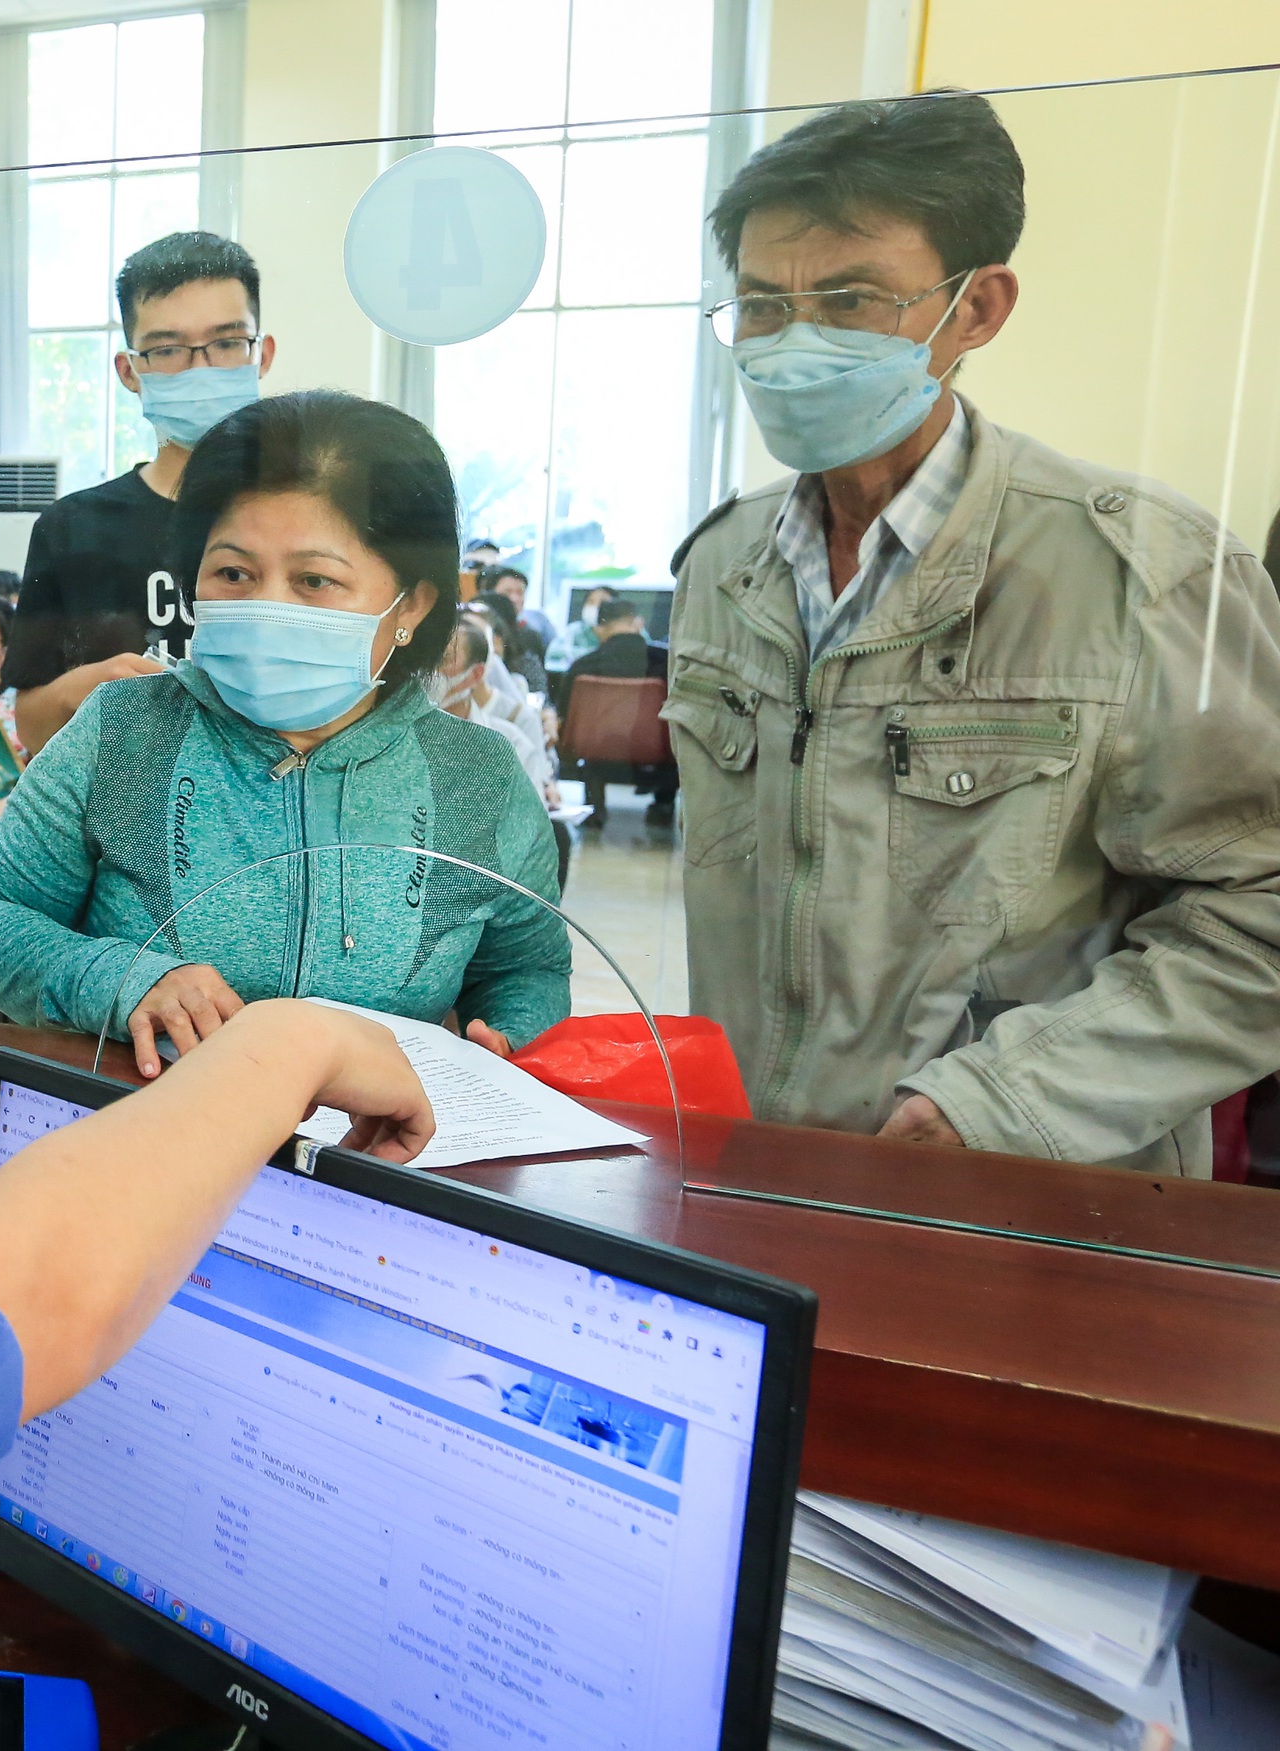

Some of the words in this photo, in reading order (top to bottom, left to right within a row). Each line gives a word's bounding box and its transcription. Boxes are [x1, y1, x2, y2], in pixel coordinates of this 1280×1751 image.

[187, 1273, 212, 1290] HUNG
[261, 1451, 282, 1469] Thành
[283, 1460, 296, 1475] phố
[297, 1467, 307, 1480] Hồ
[322, 1480, 339, 1495] Minh
[225, 1561, 243, 1576] Email
[467, 1623, 489, 1642] Công
[505, 1640, 530, 1661] Thành
[226, 1683, 269, 1721] AOC
[450, 1699, 484, 1727] VIETTEL
[487, 1719, 511, 1741] POST
